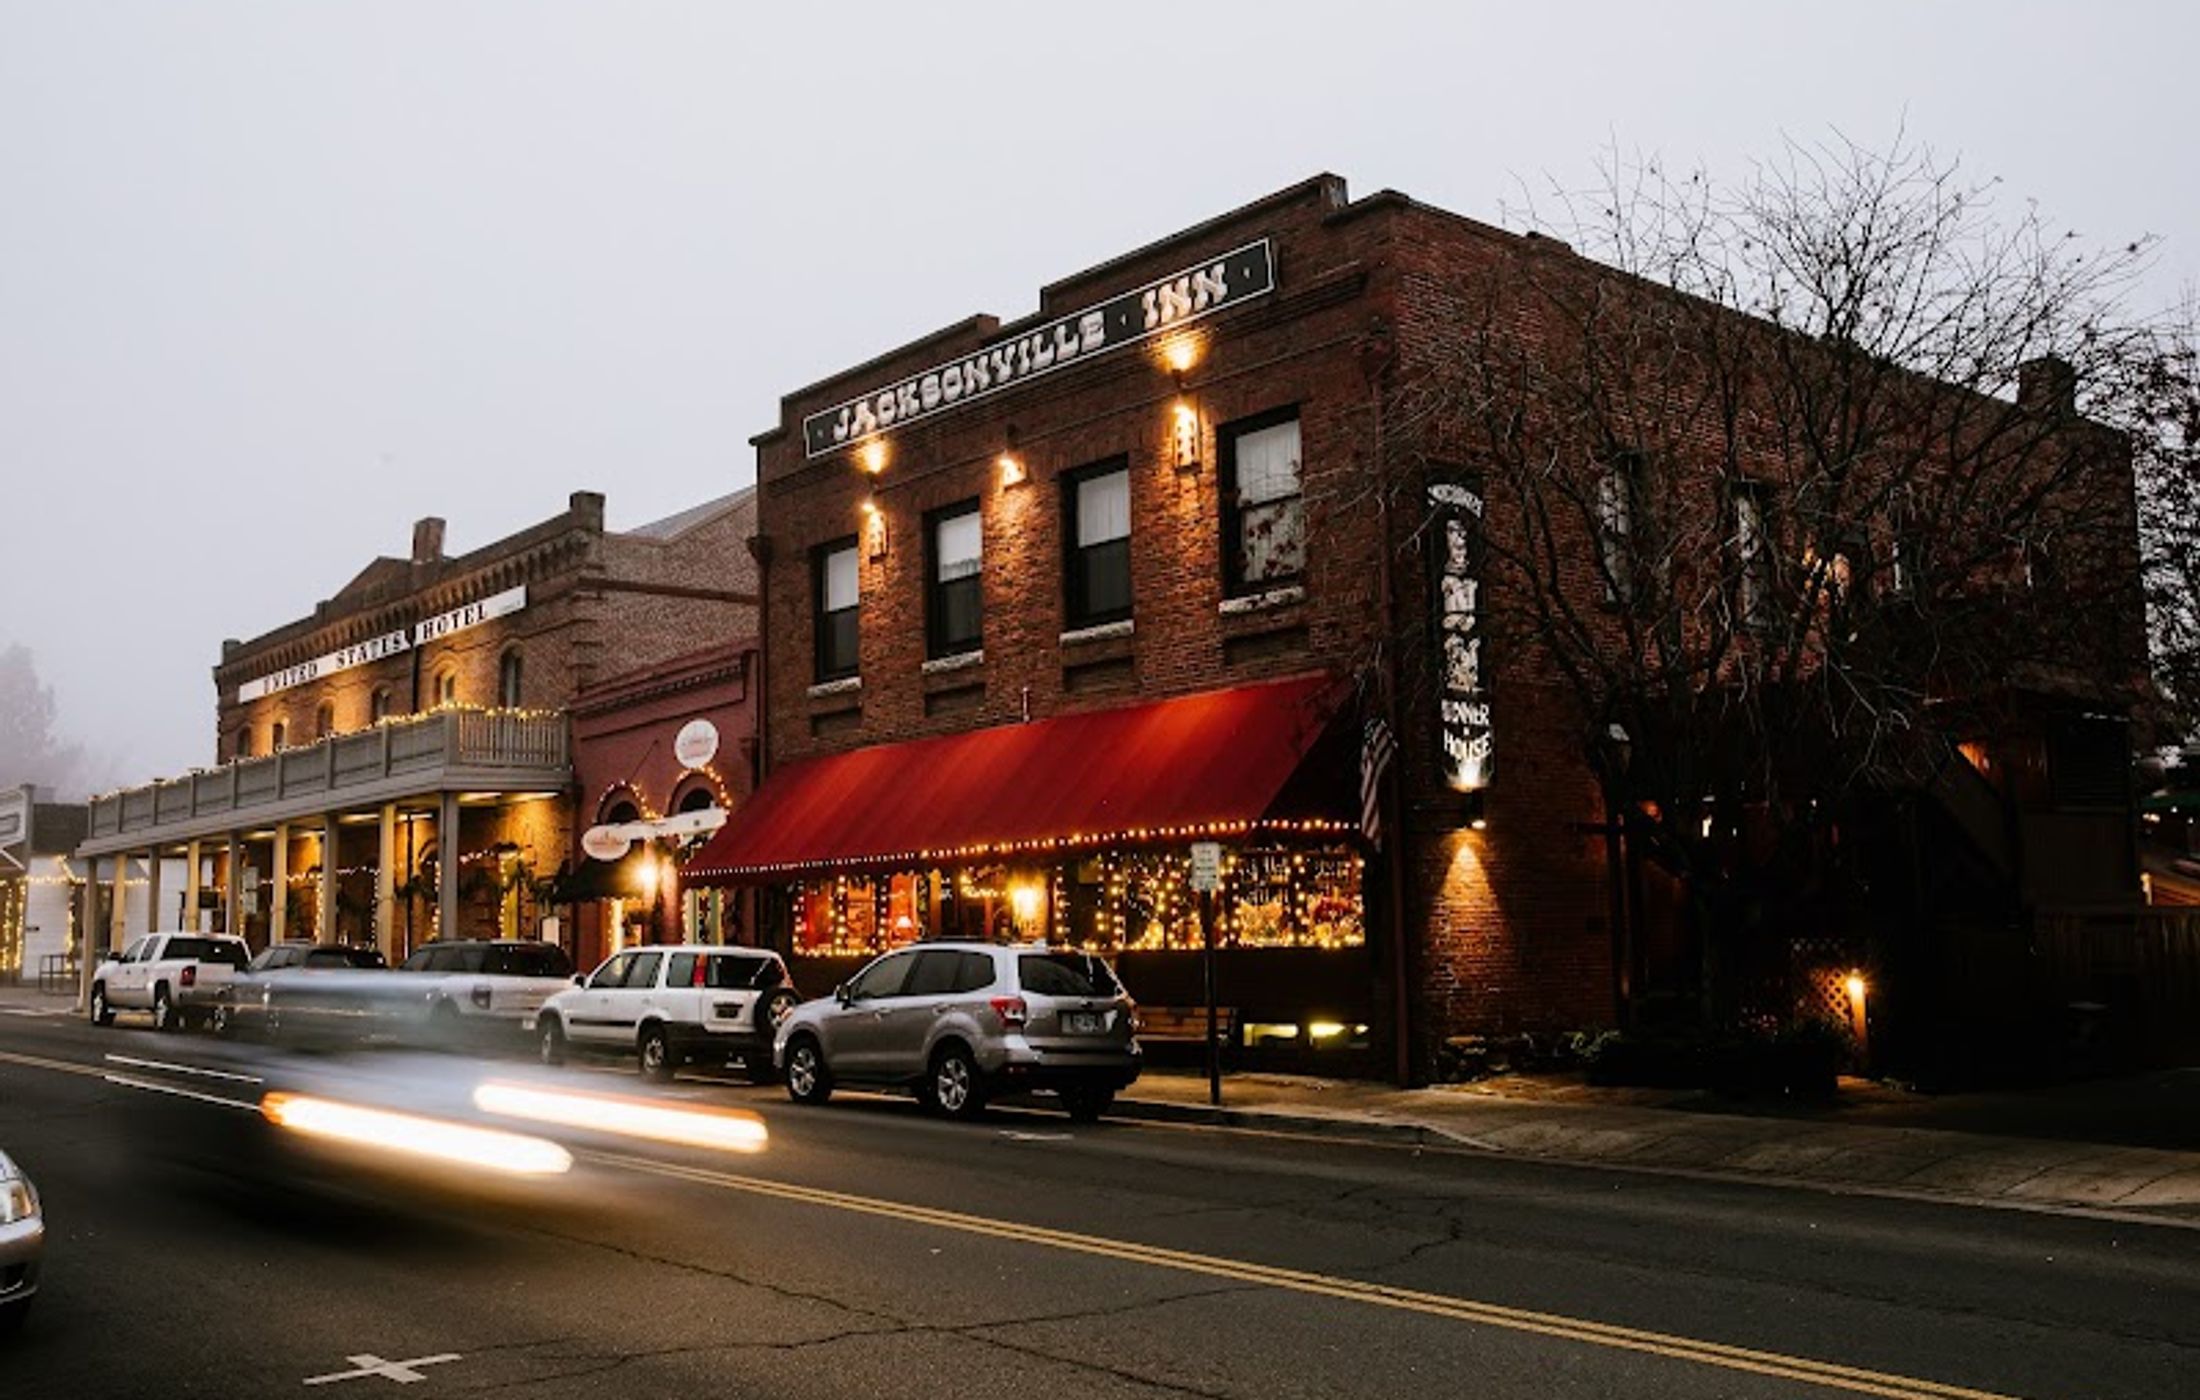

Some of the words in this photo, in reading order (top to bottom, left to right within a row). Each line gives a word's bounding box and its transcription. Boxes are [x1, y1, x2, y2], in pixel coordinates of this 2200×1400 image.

[833, 311, 1106, 441] JACKSONVILLE
[1142, 263, 1228, 329] INN
[264, 662, 318, 694] UNITED
[336, 631, 401, 669] STATES
[423, 602, 487, 640] HOTEL
[1443, 728, 1492, 761] HOUSE
